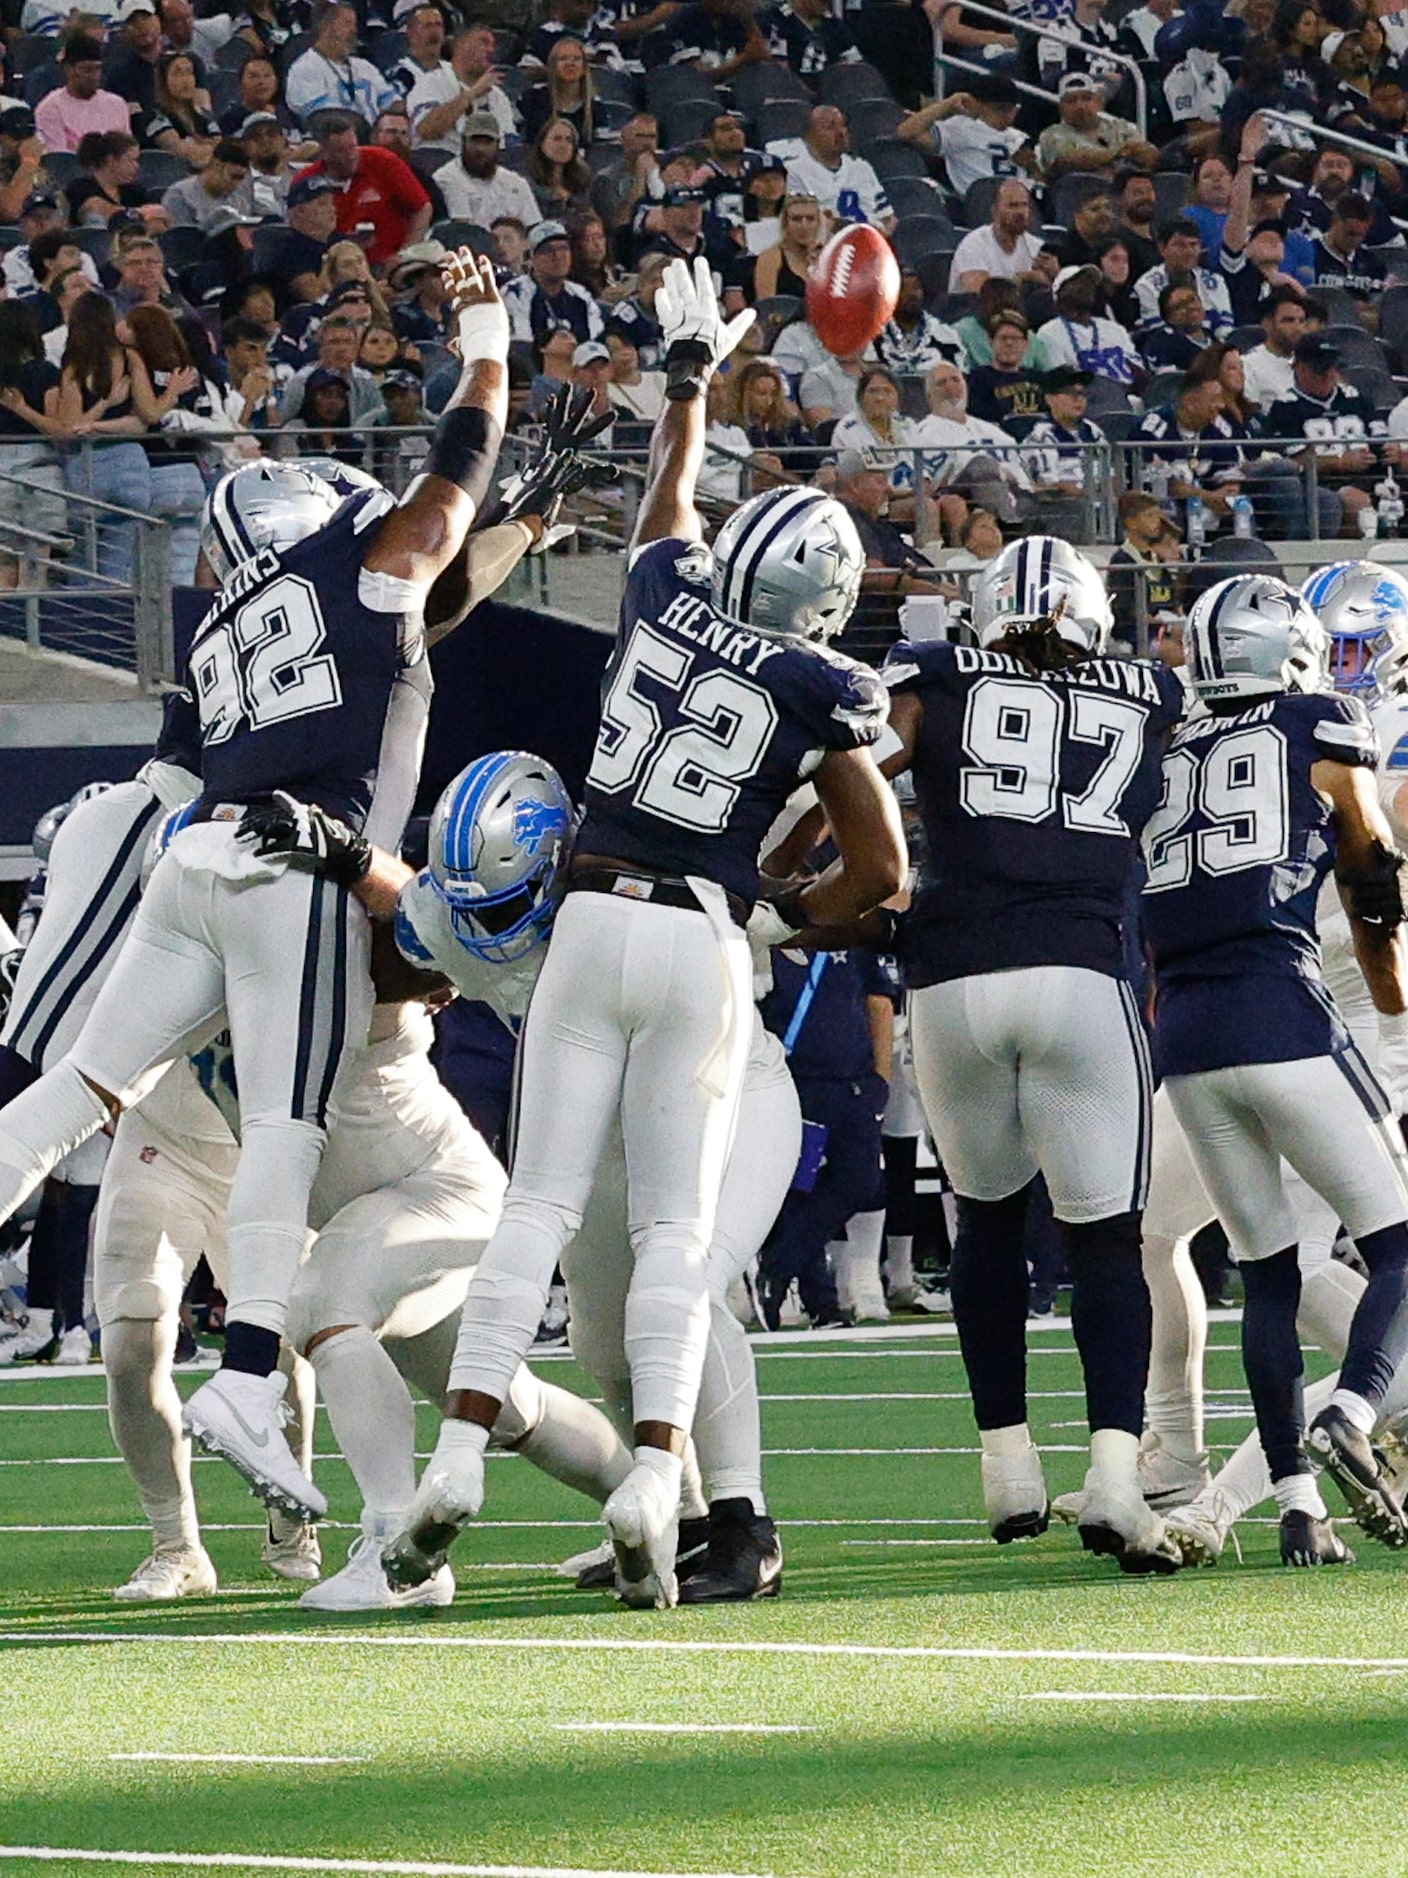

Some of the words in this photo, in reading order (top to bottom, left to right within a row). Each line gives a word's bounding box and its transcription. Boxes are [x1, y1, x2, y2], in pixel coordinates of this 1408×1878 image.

[188, 572, 344, 748] 92
[657, 591, 785, 676] HENRY
[585, 618, 780, 834] 52
[960, 676, 1150, 838] 97
[1140, 723, 1289, 894] 29
